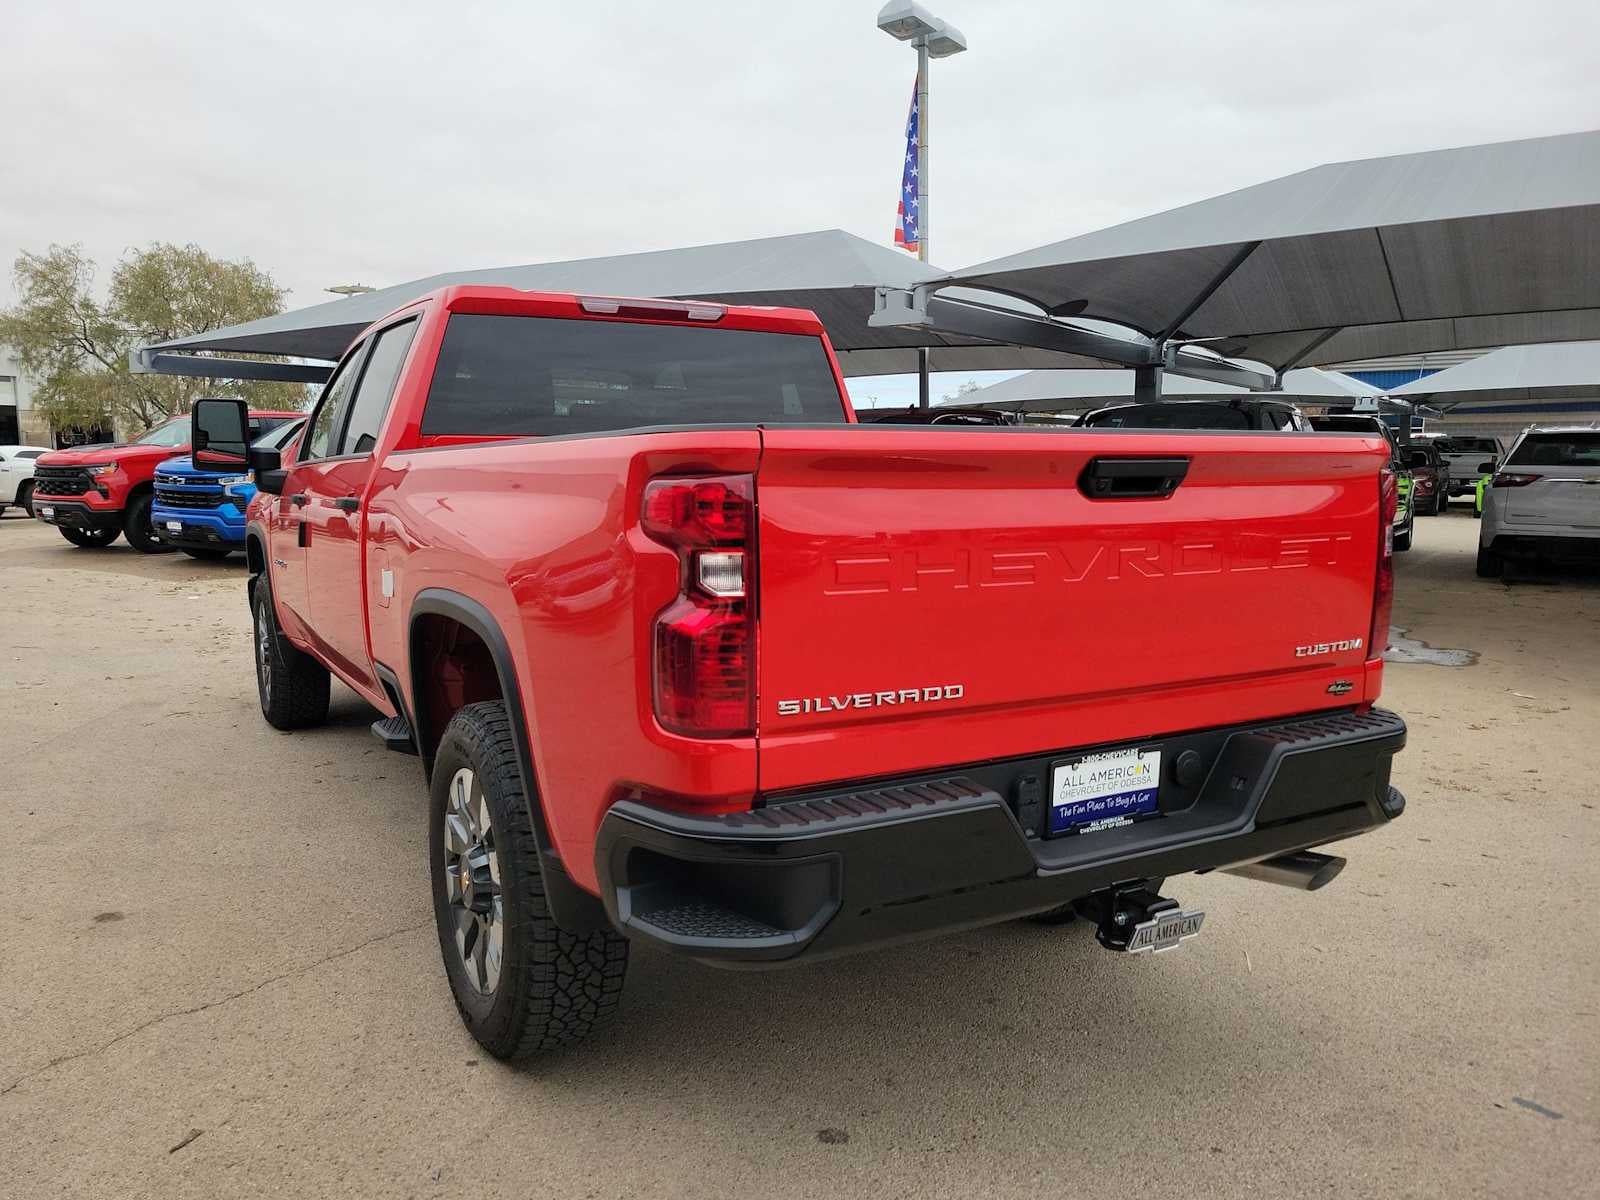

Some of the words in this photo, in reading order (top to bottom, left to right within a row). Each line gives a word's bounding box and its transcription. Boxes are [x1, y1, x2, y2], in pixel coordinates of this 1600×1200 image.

[823, 534, 1352, 596] CHEVROLET
[1295, 638, 1362, 657] CUSTOM
[777, 684, 965, 716] SILVERADO
[1060, 783, 1105, 800] CHEVROLET
[1107, 780, 1119, 790] OF
[1120, 775, 1152, 788] ODESSA
[1063, 776, 1084, 789] ALL
[1089, 763, 1151, 783] AMERICN
[1130, 793, 1137, 805] A
[1140, 927, 1154, 945] ALL
[1157, 918, 1199, 942] AMERICAN
